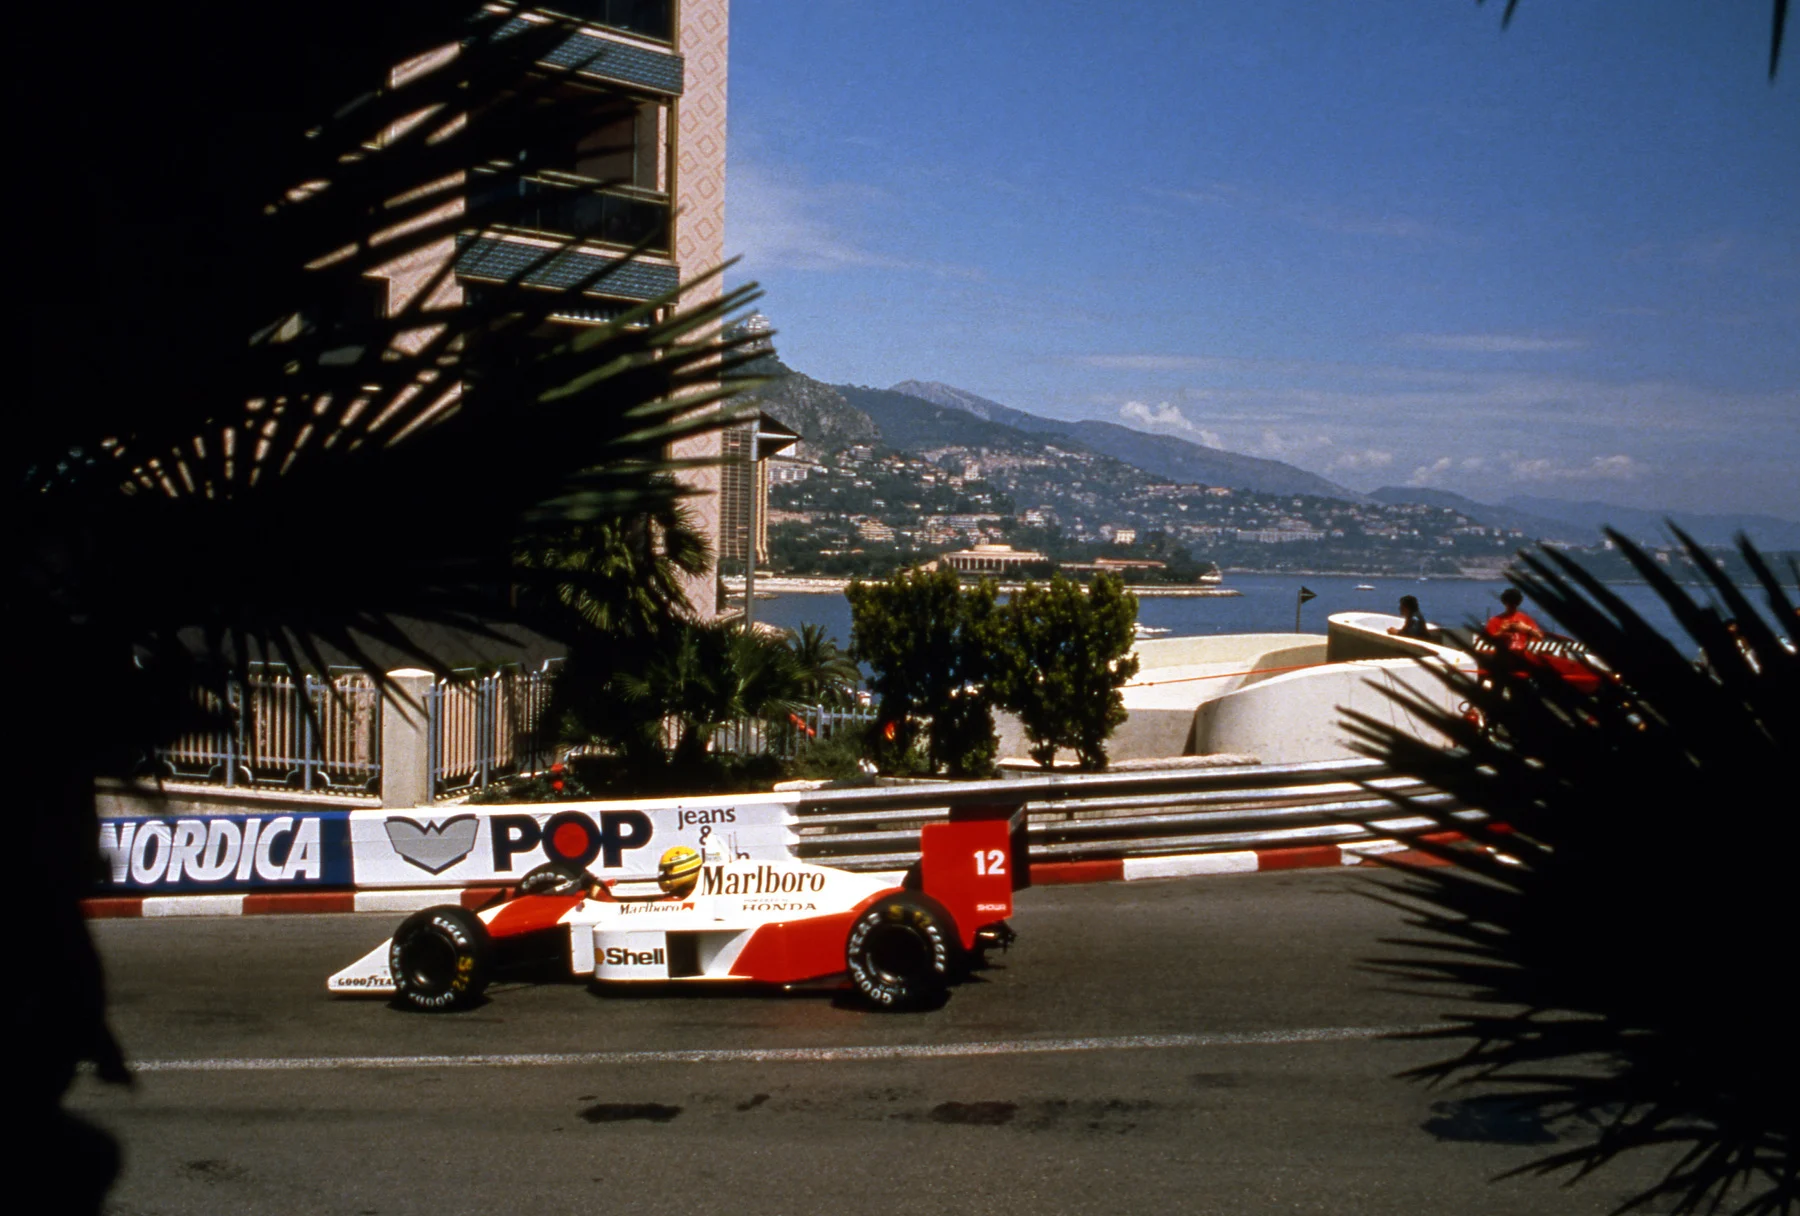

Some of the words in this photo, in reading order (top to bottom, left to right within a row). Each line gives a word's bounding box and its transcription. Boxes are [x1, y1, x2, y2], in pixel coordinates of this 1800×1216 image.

[677, 805, 736, 830] jeans
[99, 817, 320, 884] NORDICA
[489, 810, 653, 872] POP
[973, 849, 1006, 875] 12
[701, 865, 826, 896] Marlboro
[618, 902, 680, 915] Marlboro
[742, 902, 817, 911] HONDA
[432, 916, 468, 945] EAGLE
[605, 947, 665, 966] Shell
[338, 975, 394, 988] GOODYEA
